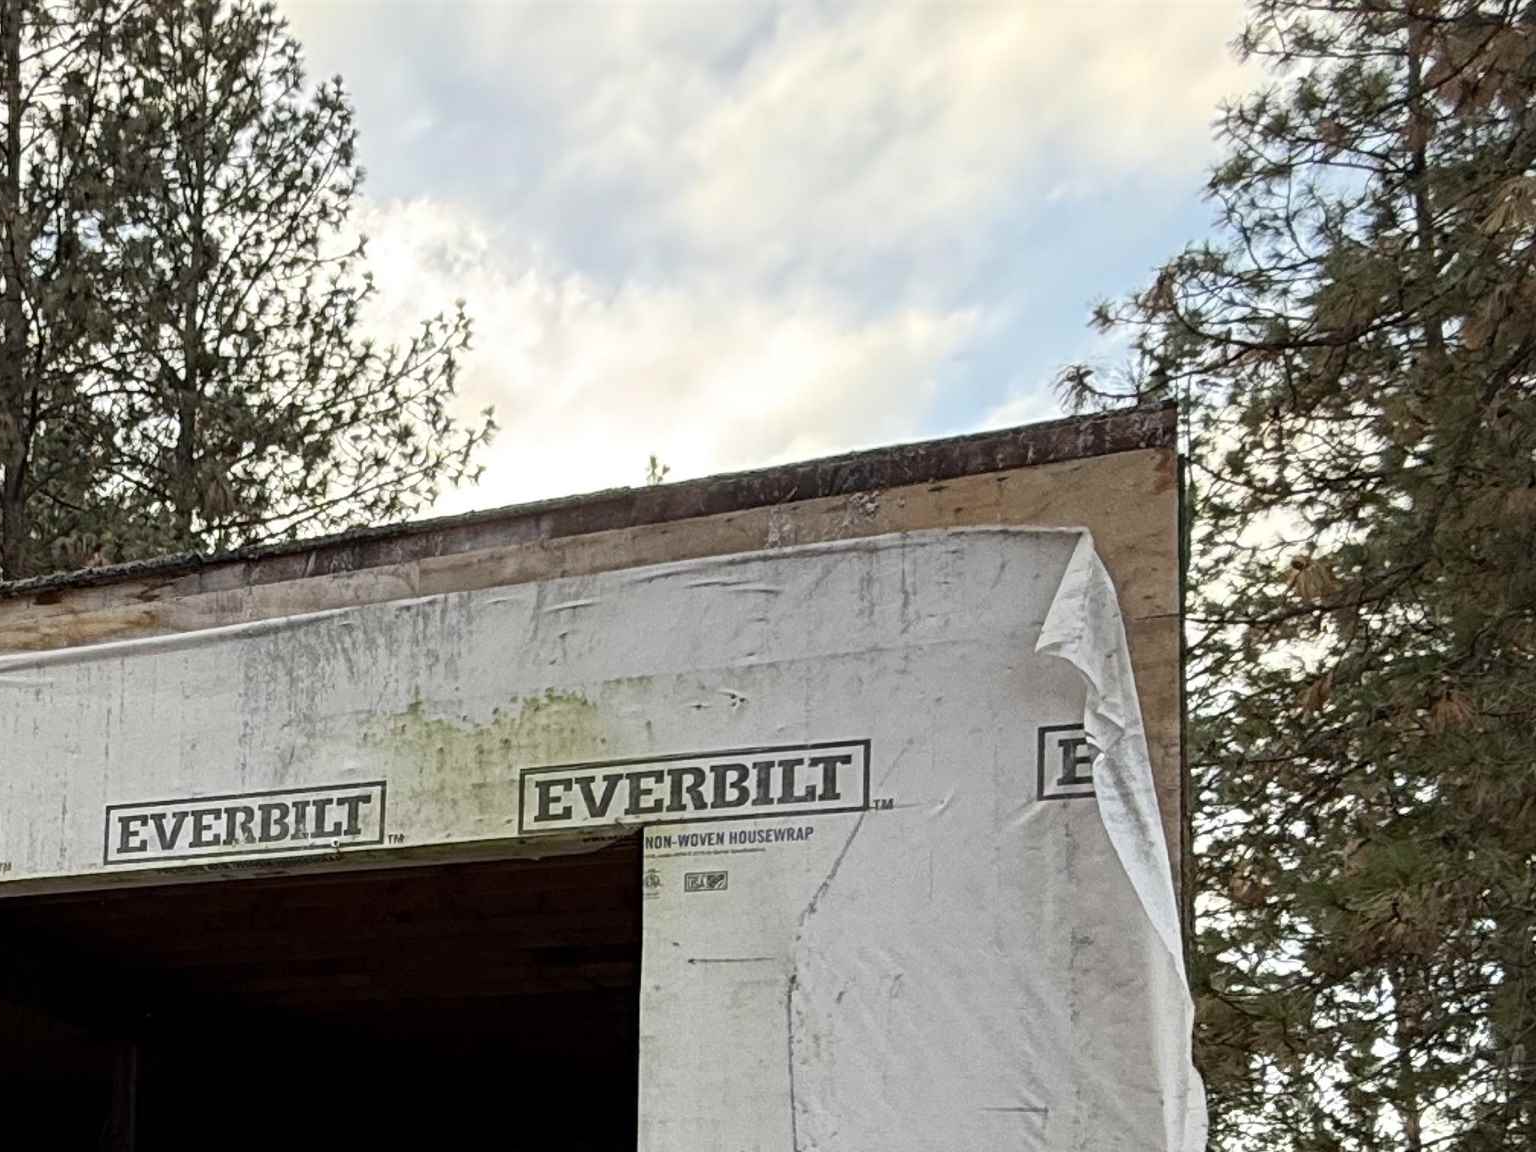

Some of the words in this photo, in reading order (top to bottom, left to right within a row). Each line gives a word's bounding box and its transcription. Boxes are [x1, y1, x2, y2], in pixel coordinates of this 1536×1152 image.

[533, 754, 852, 822] EVERBILT
[116, 794, 372, 854] EVERBILT
[644, 831, 724, 849] NON-WOVEN
[728, 826, 814, 845] HOUSEWRAP
